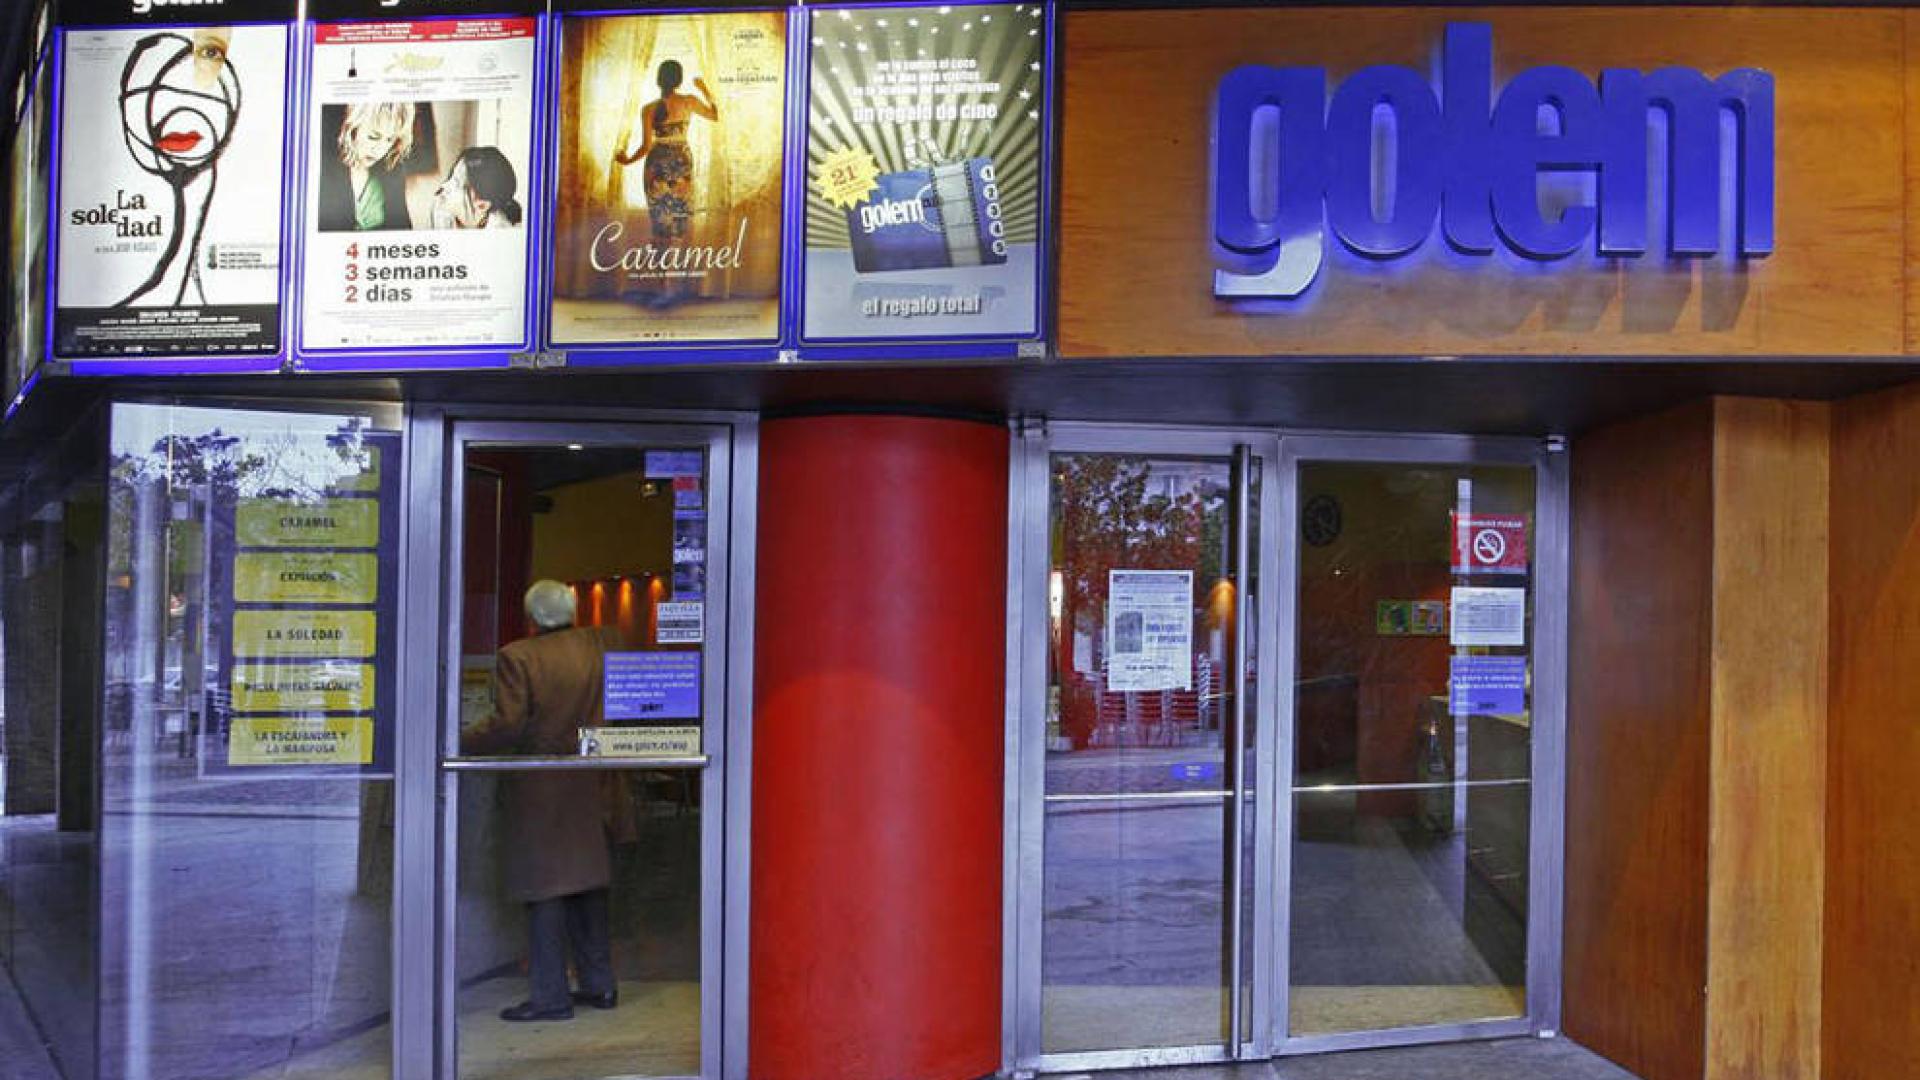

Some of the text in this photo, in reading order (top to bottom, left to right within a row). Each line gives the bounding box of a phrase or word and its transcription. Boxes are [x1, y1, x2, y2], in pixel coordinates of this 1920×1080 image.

[853, 102, 998, 124] un regalo de cine
[1215, 22, 1775, 298] golem
[117, 190, 146, 210] La
[861, 198, 924, 233] golem
[344, 242, 440, 259] 4 meses
[591, 217, 748, 271] Caramel
[345, 263, 468, 281] 3 semanas
[345, 285, 359, 303] 2
[863, 294, 982, 318] el regalo total
[267, 629, 343, 640] LA SOLEDAD
